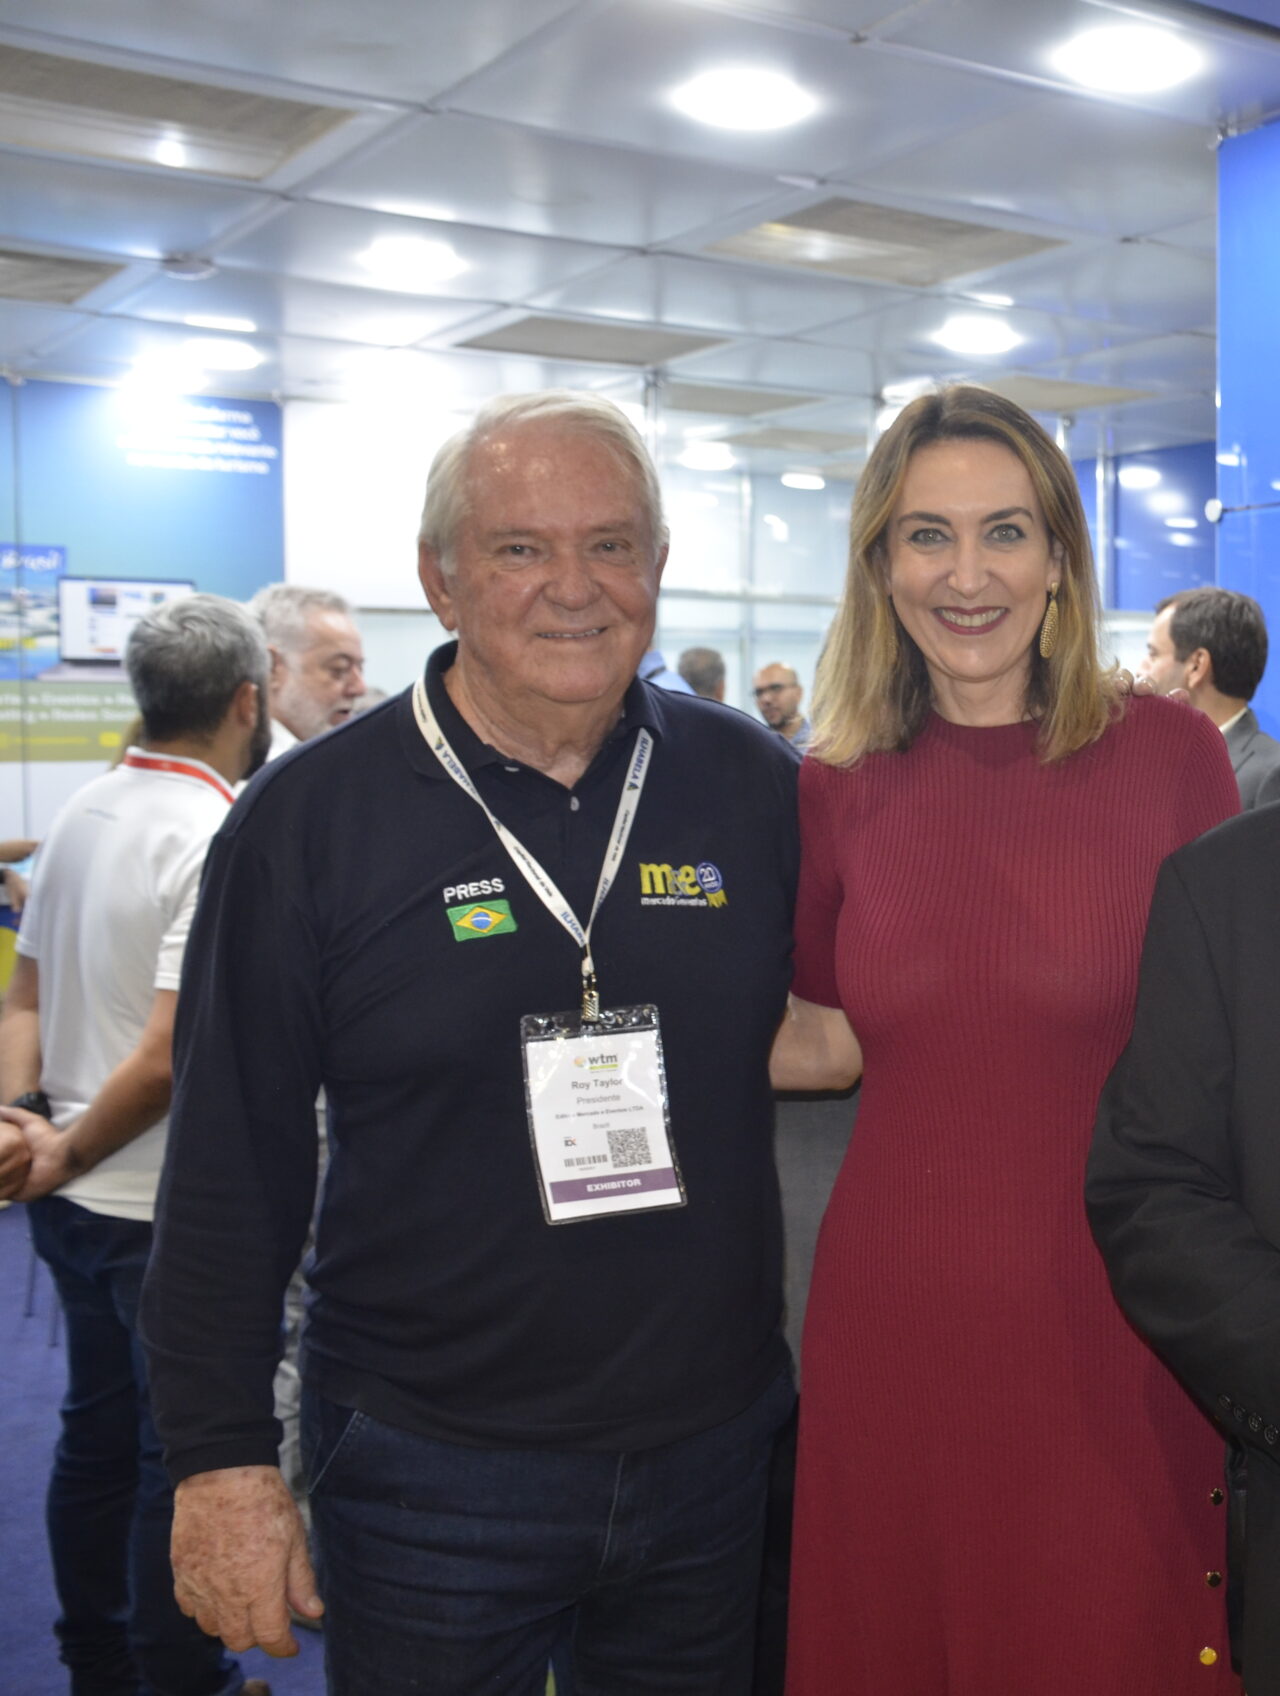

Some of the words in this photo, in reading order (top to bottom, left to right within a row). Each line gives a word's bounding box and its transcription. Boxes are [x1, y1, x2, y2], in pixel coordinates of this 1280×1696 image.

[639, 863, 702, 896] m&e
[700, 867, 717, 882] 20
[443, 878, 505, 903] PRESS
[588, 1053, 617, 1065] wtm
[571, 1081, 591, 1090] Roy
[593, 1078, 623, 1089] Taylor
[576, 1094, 621, 1104] Presidente
[586, 1178, 642, 1193] EXHIBITOR
